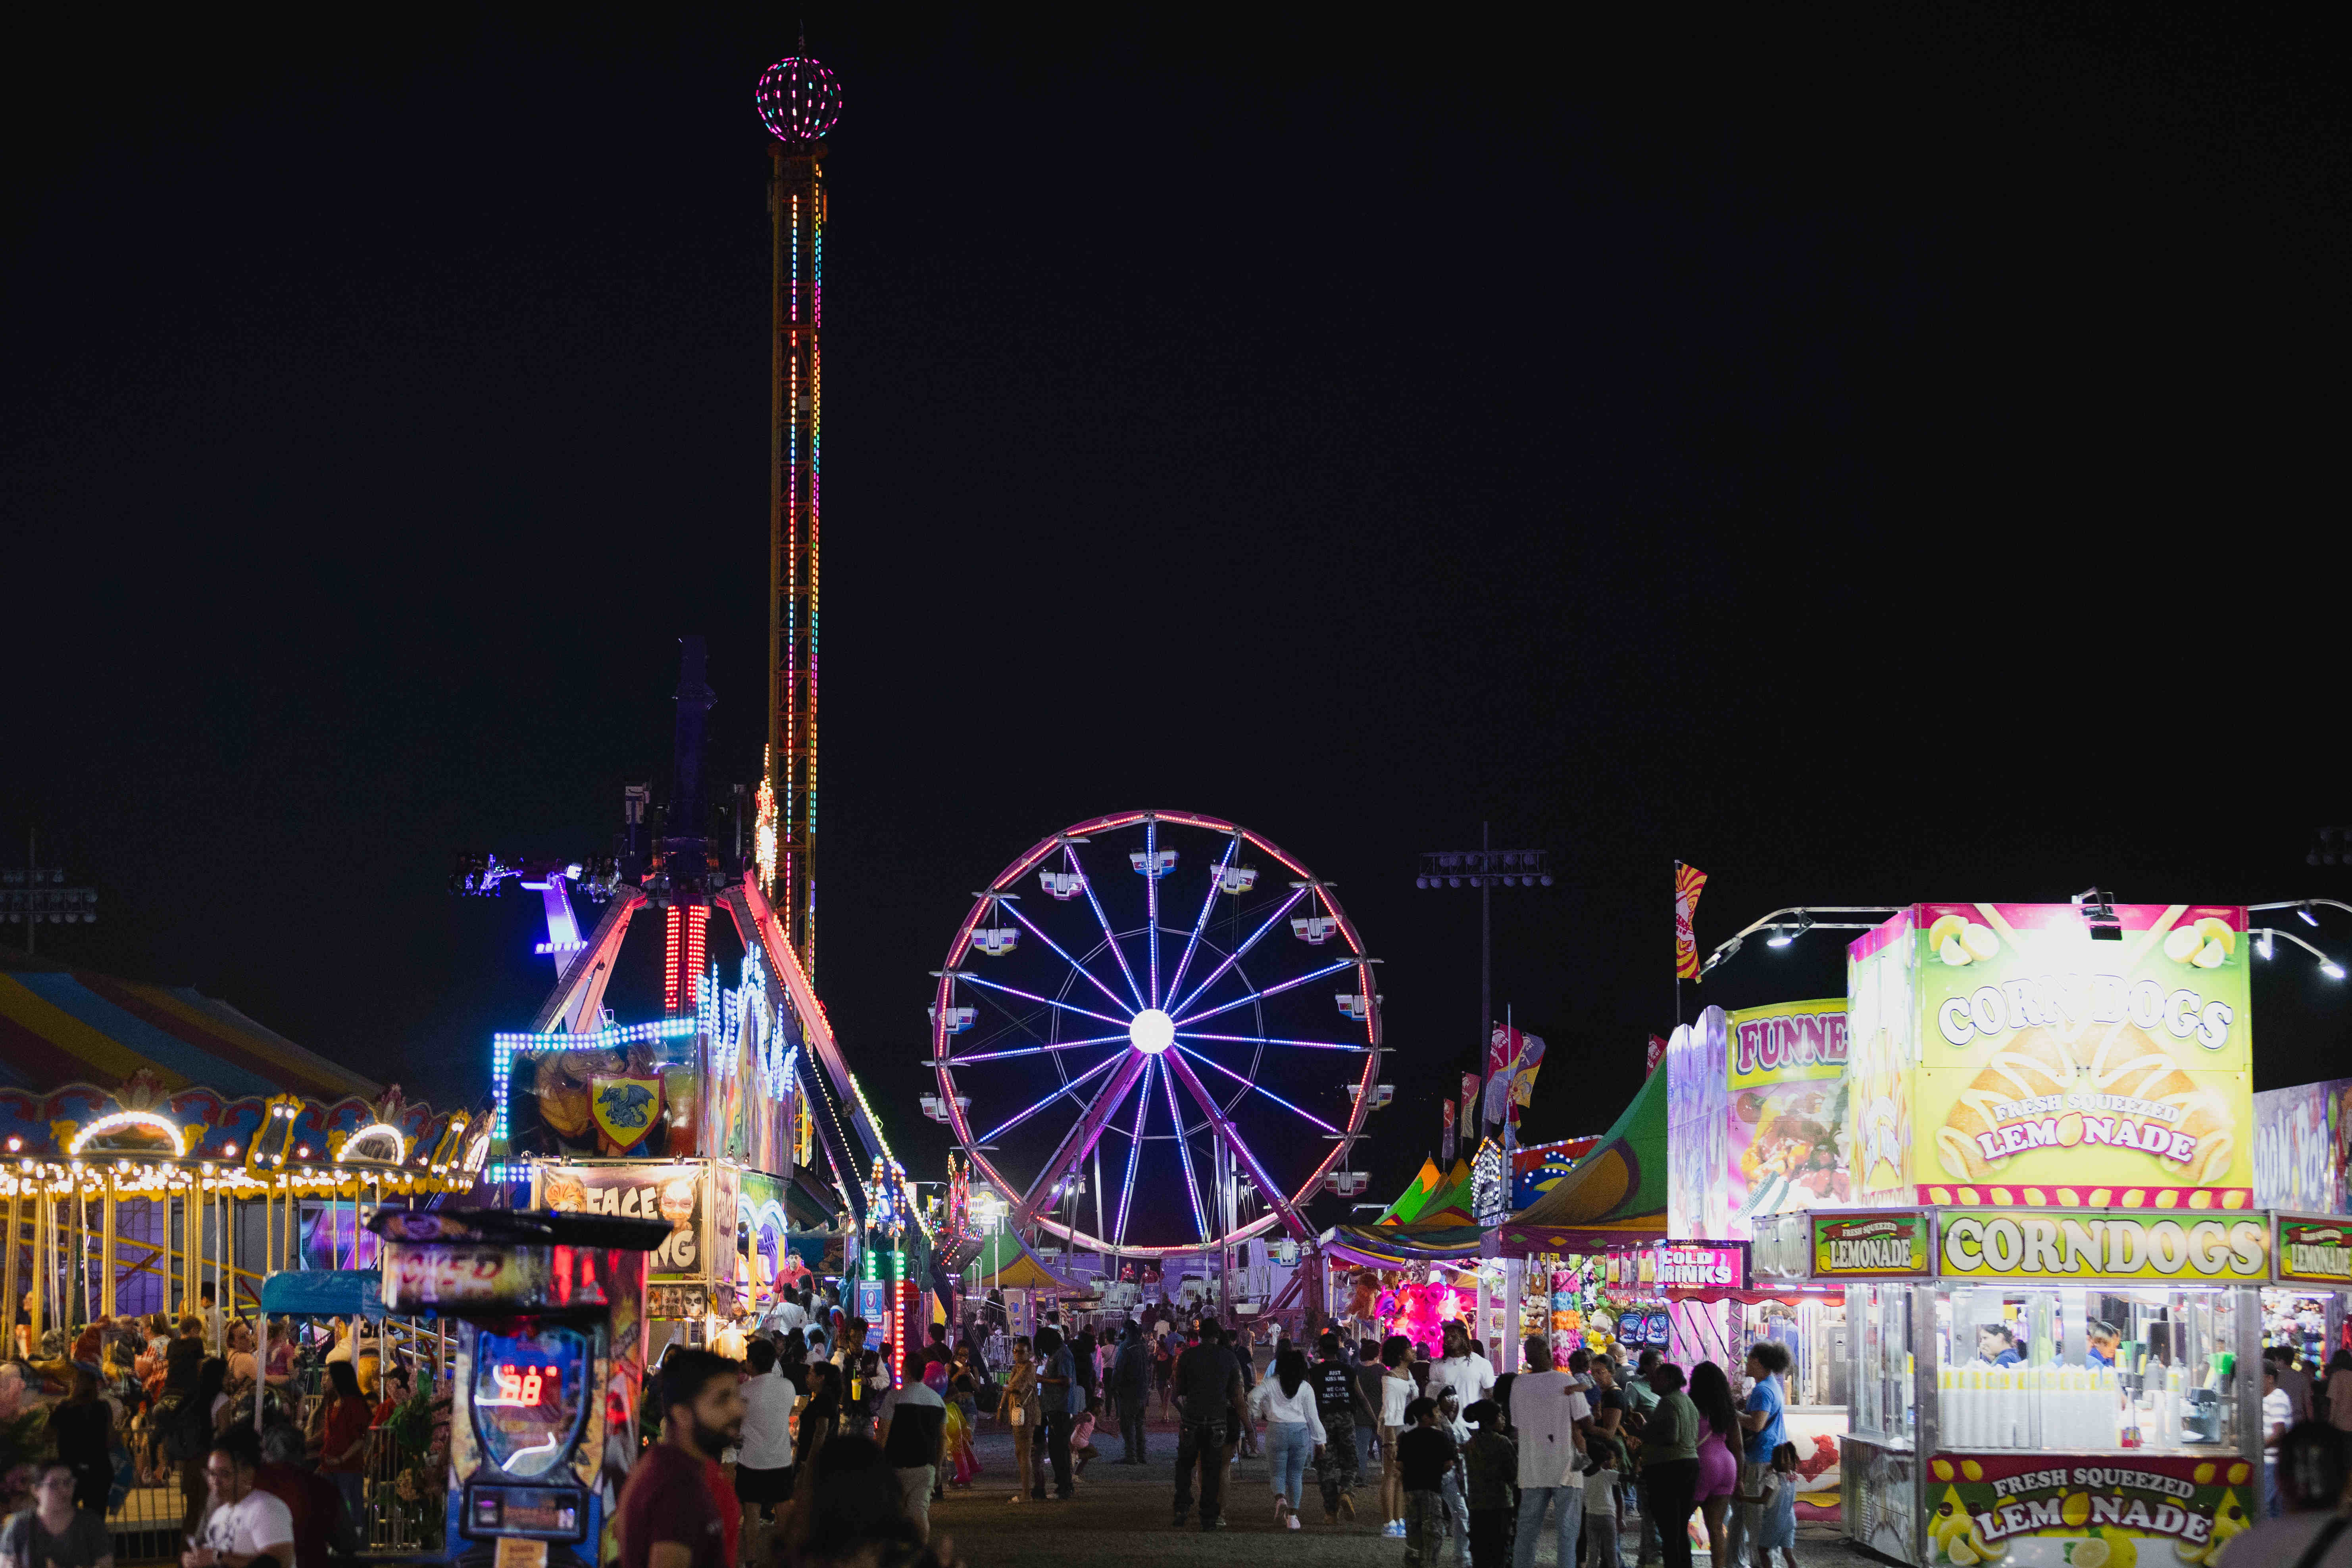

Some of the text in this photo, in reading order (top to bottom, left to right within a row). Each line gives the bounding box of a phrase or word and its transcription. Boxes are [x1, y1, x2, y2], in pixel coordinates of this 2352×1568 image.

[1992, 1093, 2180, 1123] FRESH SQUEEZED
[586, 1186, 658, 1219] FACE
[1842, 1222, 1897, 1237] FRESH SQUEEZED
[1663, 1251, 1712, 1265] COLD
[1830, 1239, 1912, 1268] LEMONADE
[1945, 1216, 2265, 1276] CORNDOGS
[1657, 1265, 1732, 1284] DRINKS
[868, 1292, 874, 1306] 9
[1991, 1467, 2196, 1499] FRESH SQUEEZED
